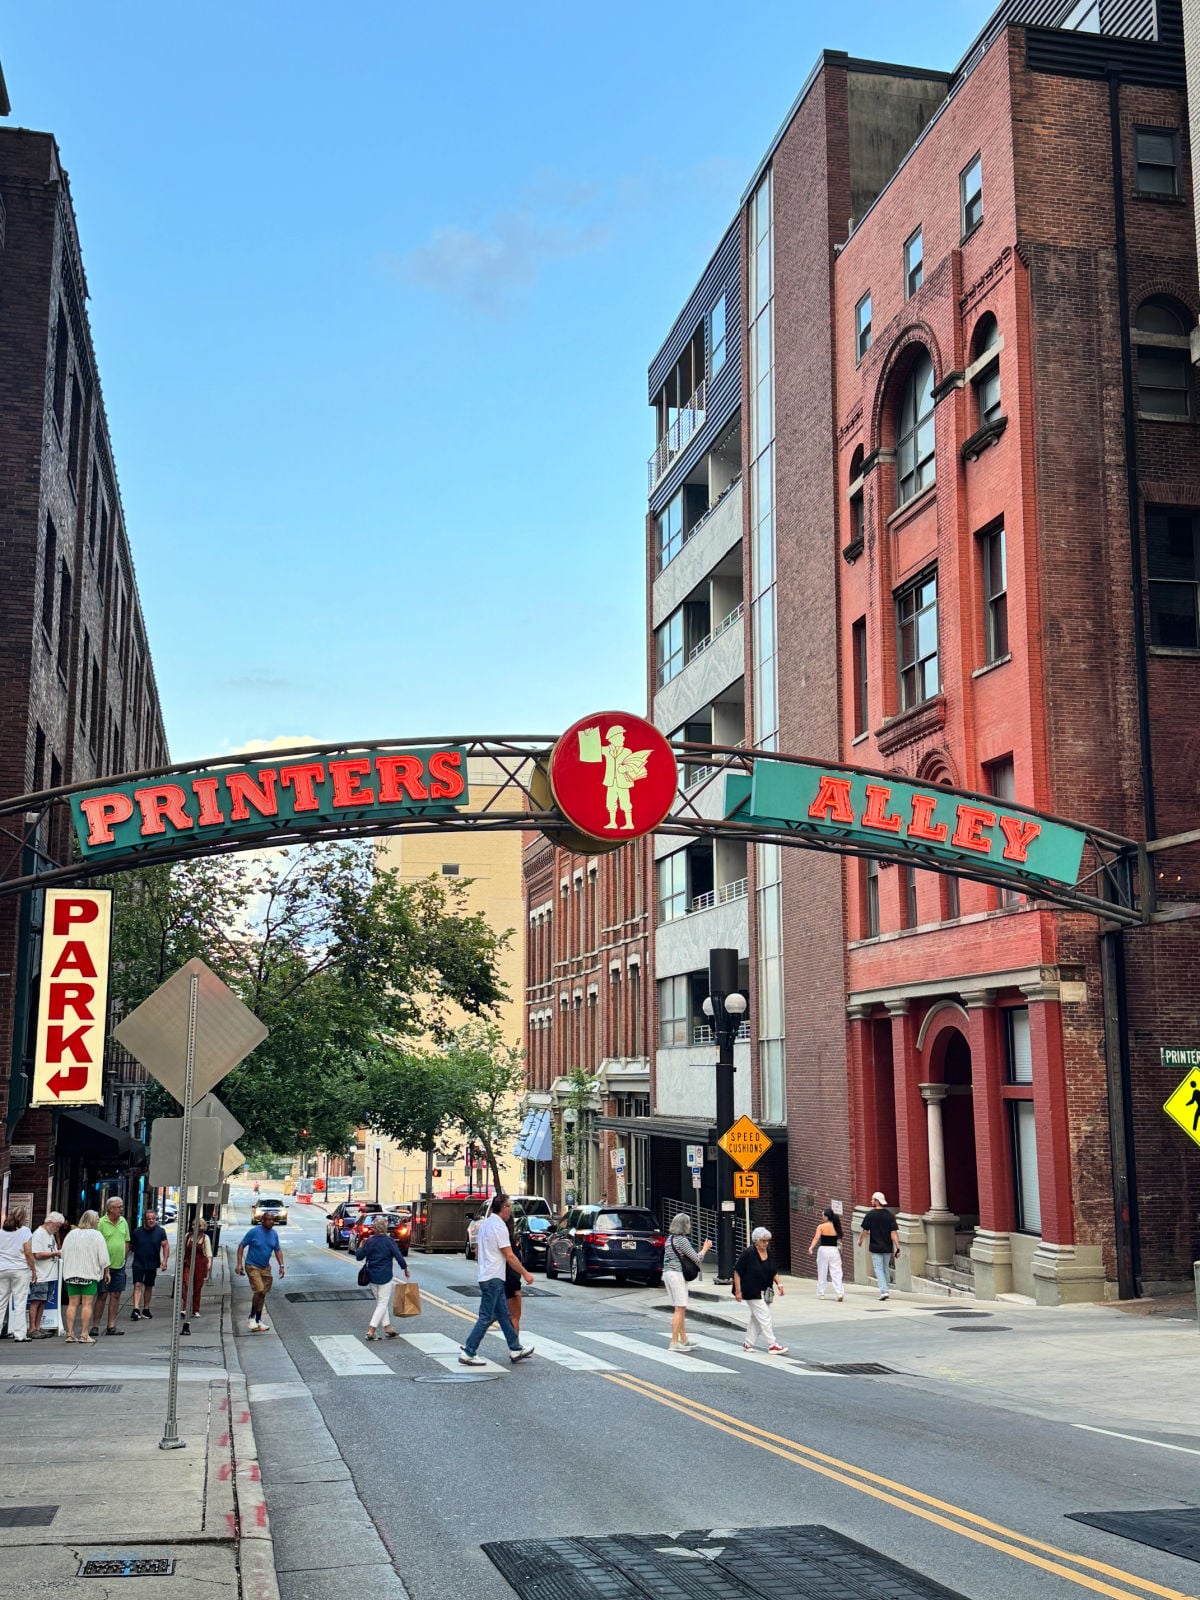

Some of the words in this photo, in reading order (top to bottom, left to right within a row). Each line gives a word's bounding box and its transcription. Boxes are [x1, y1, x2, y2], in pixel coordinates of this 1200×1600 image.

[80, 751, 466, 847] PRINTERS
[808, 775, 1042, 863] ALLEY
[45, 898, 99, 1063] PARK
[728, 1143, 763, 1153] CUSHIONS
[730, 1132, 760, 1142] SPEED
[738, 1175, 755, 1188] 15
